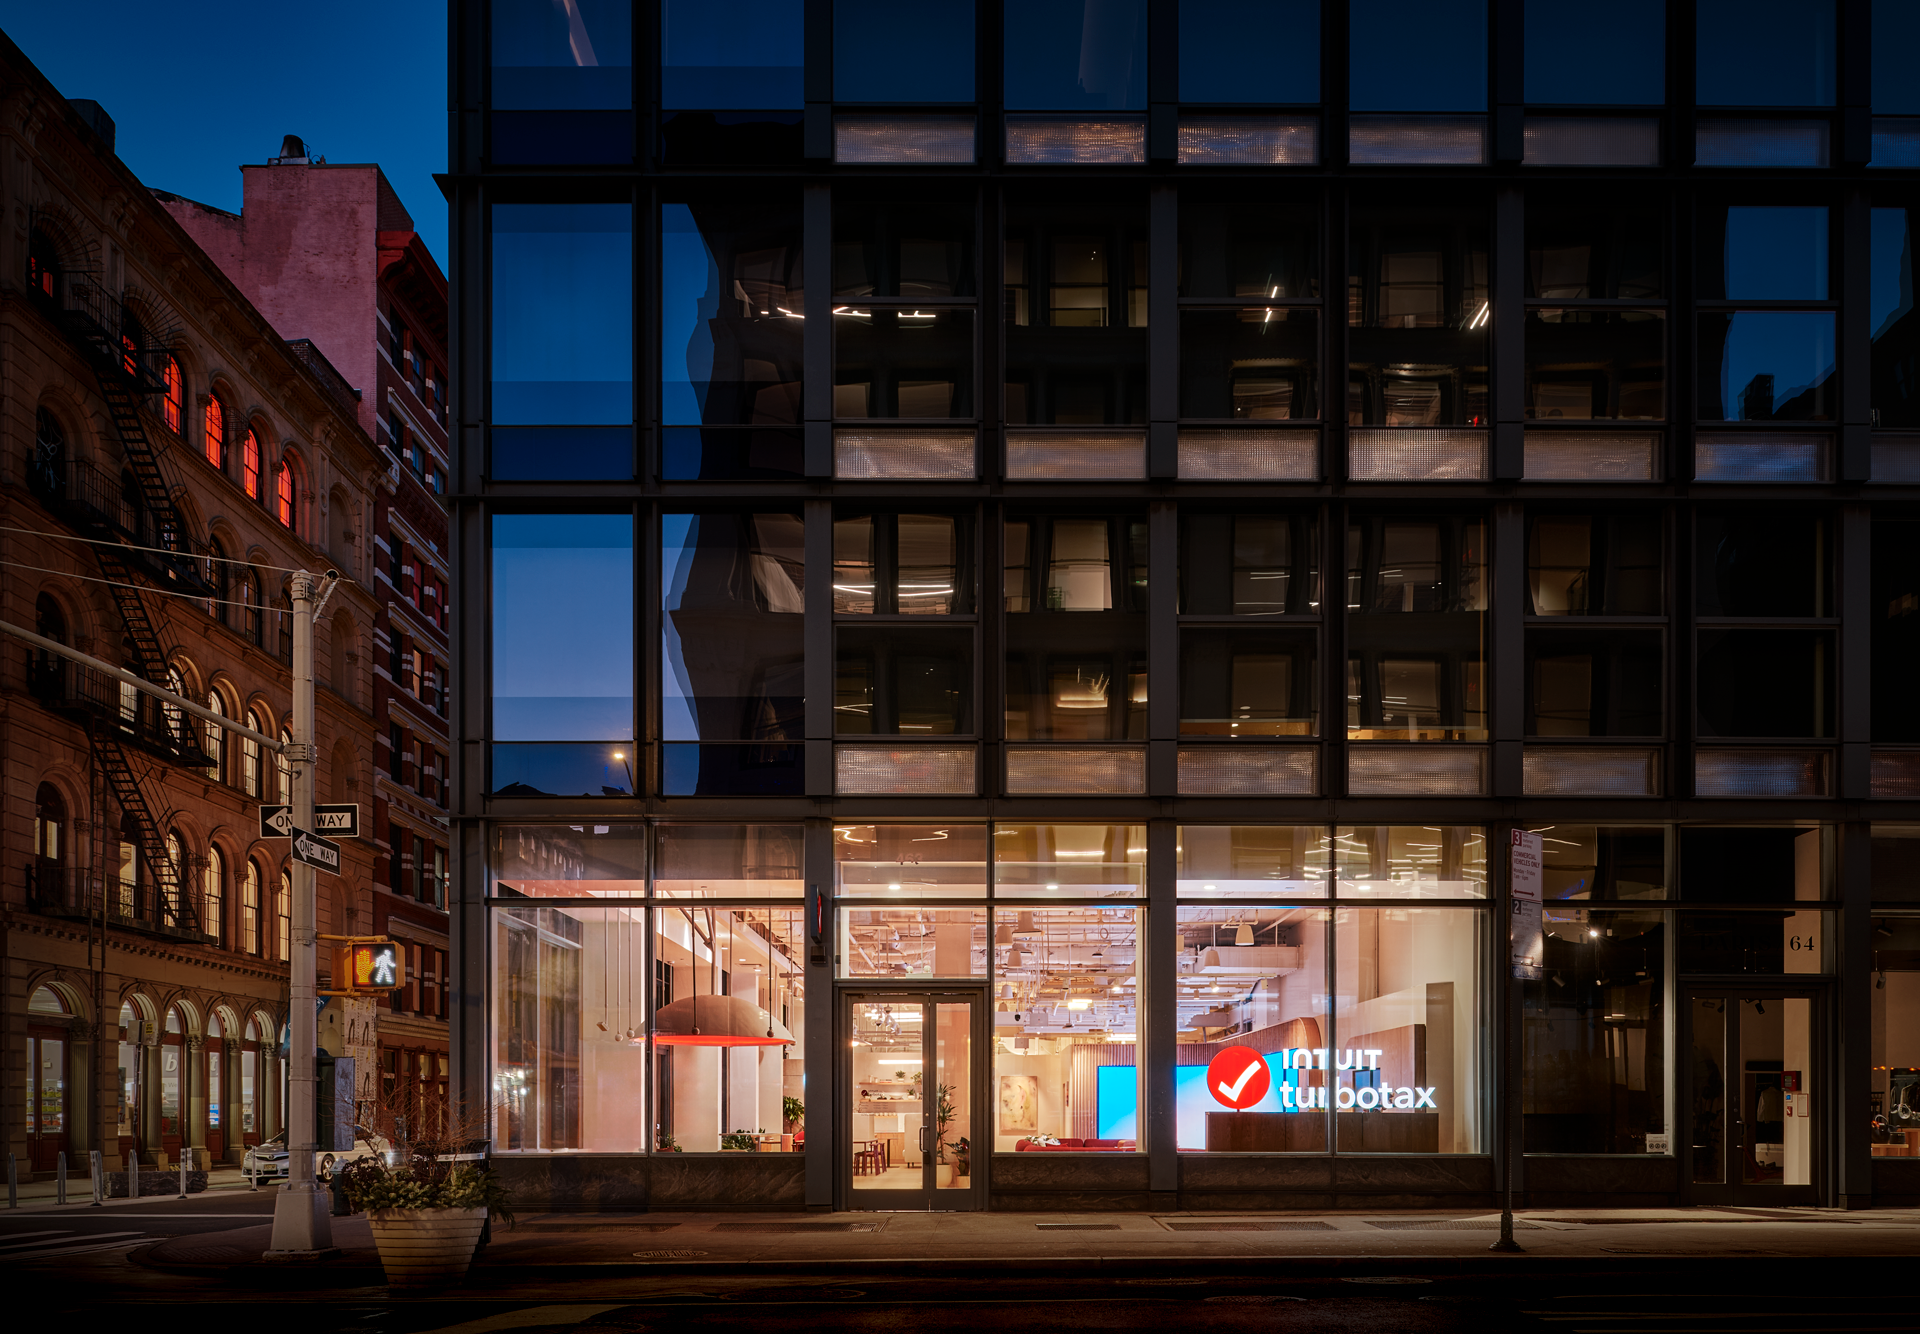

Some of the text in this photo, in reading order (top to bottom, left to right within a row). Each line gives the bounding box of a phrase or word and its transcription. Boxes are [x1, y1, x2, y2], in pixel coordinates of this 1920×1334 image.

[276, 815, 345, 827] ON WAY
[1514, 832, 1520, 844] 3
[300, 840, 335, 863] ONE WAY
[1513, 850, 1537, 860] COMMERCIAL
[1513, 858, 1530, 867] VEHICLES
[1514, 900, 1520, 913] 2
[1790, 935, 1815, 951] 64
[1282, 1048, 1383, 1071] INTUIT
[1279, 1076, 1438, 1109] turbotax
